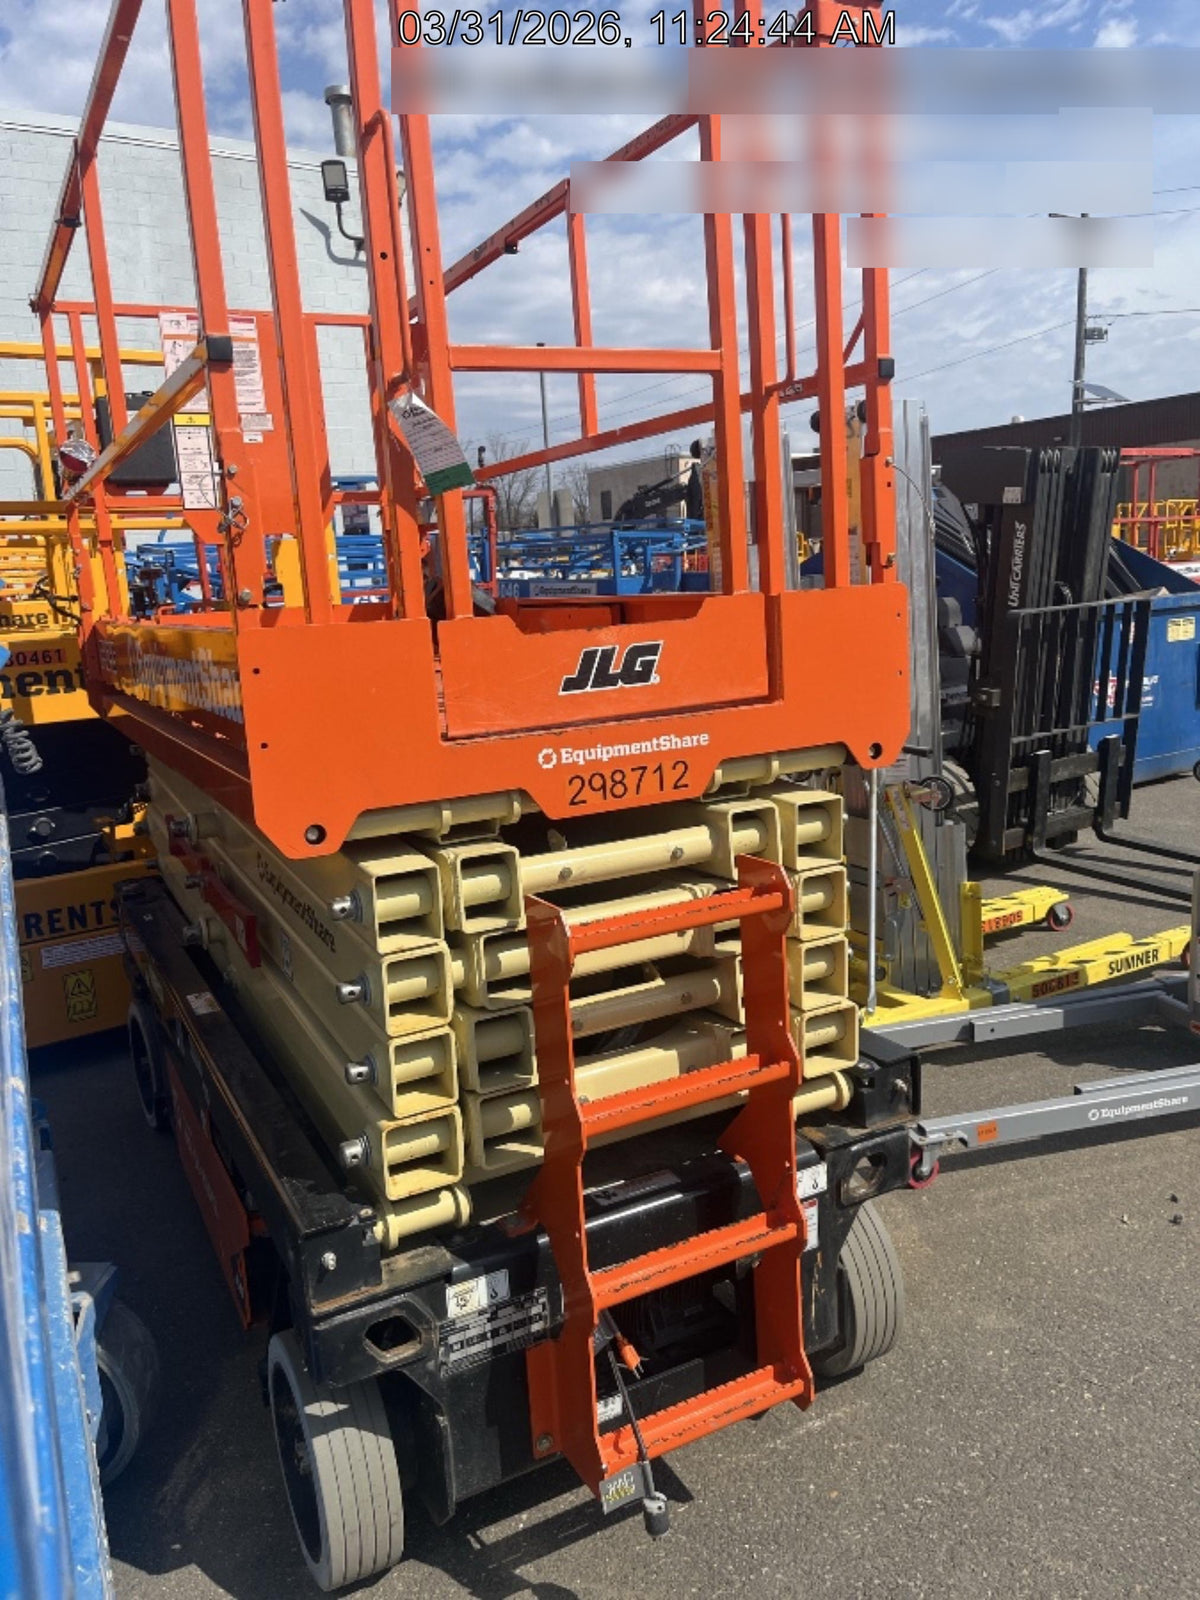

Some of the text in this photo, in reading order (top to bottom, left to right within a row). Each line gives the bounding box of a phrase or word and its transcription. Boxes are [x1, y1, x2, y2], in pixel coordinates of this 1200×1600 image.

[558, 640, 664, 695] JLG
[561, 733, 710, 766] EquipmentShare
[568, 760, 690, 806] 298712
[1101, 1096, 1189, 1119] EquipmentShare
